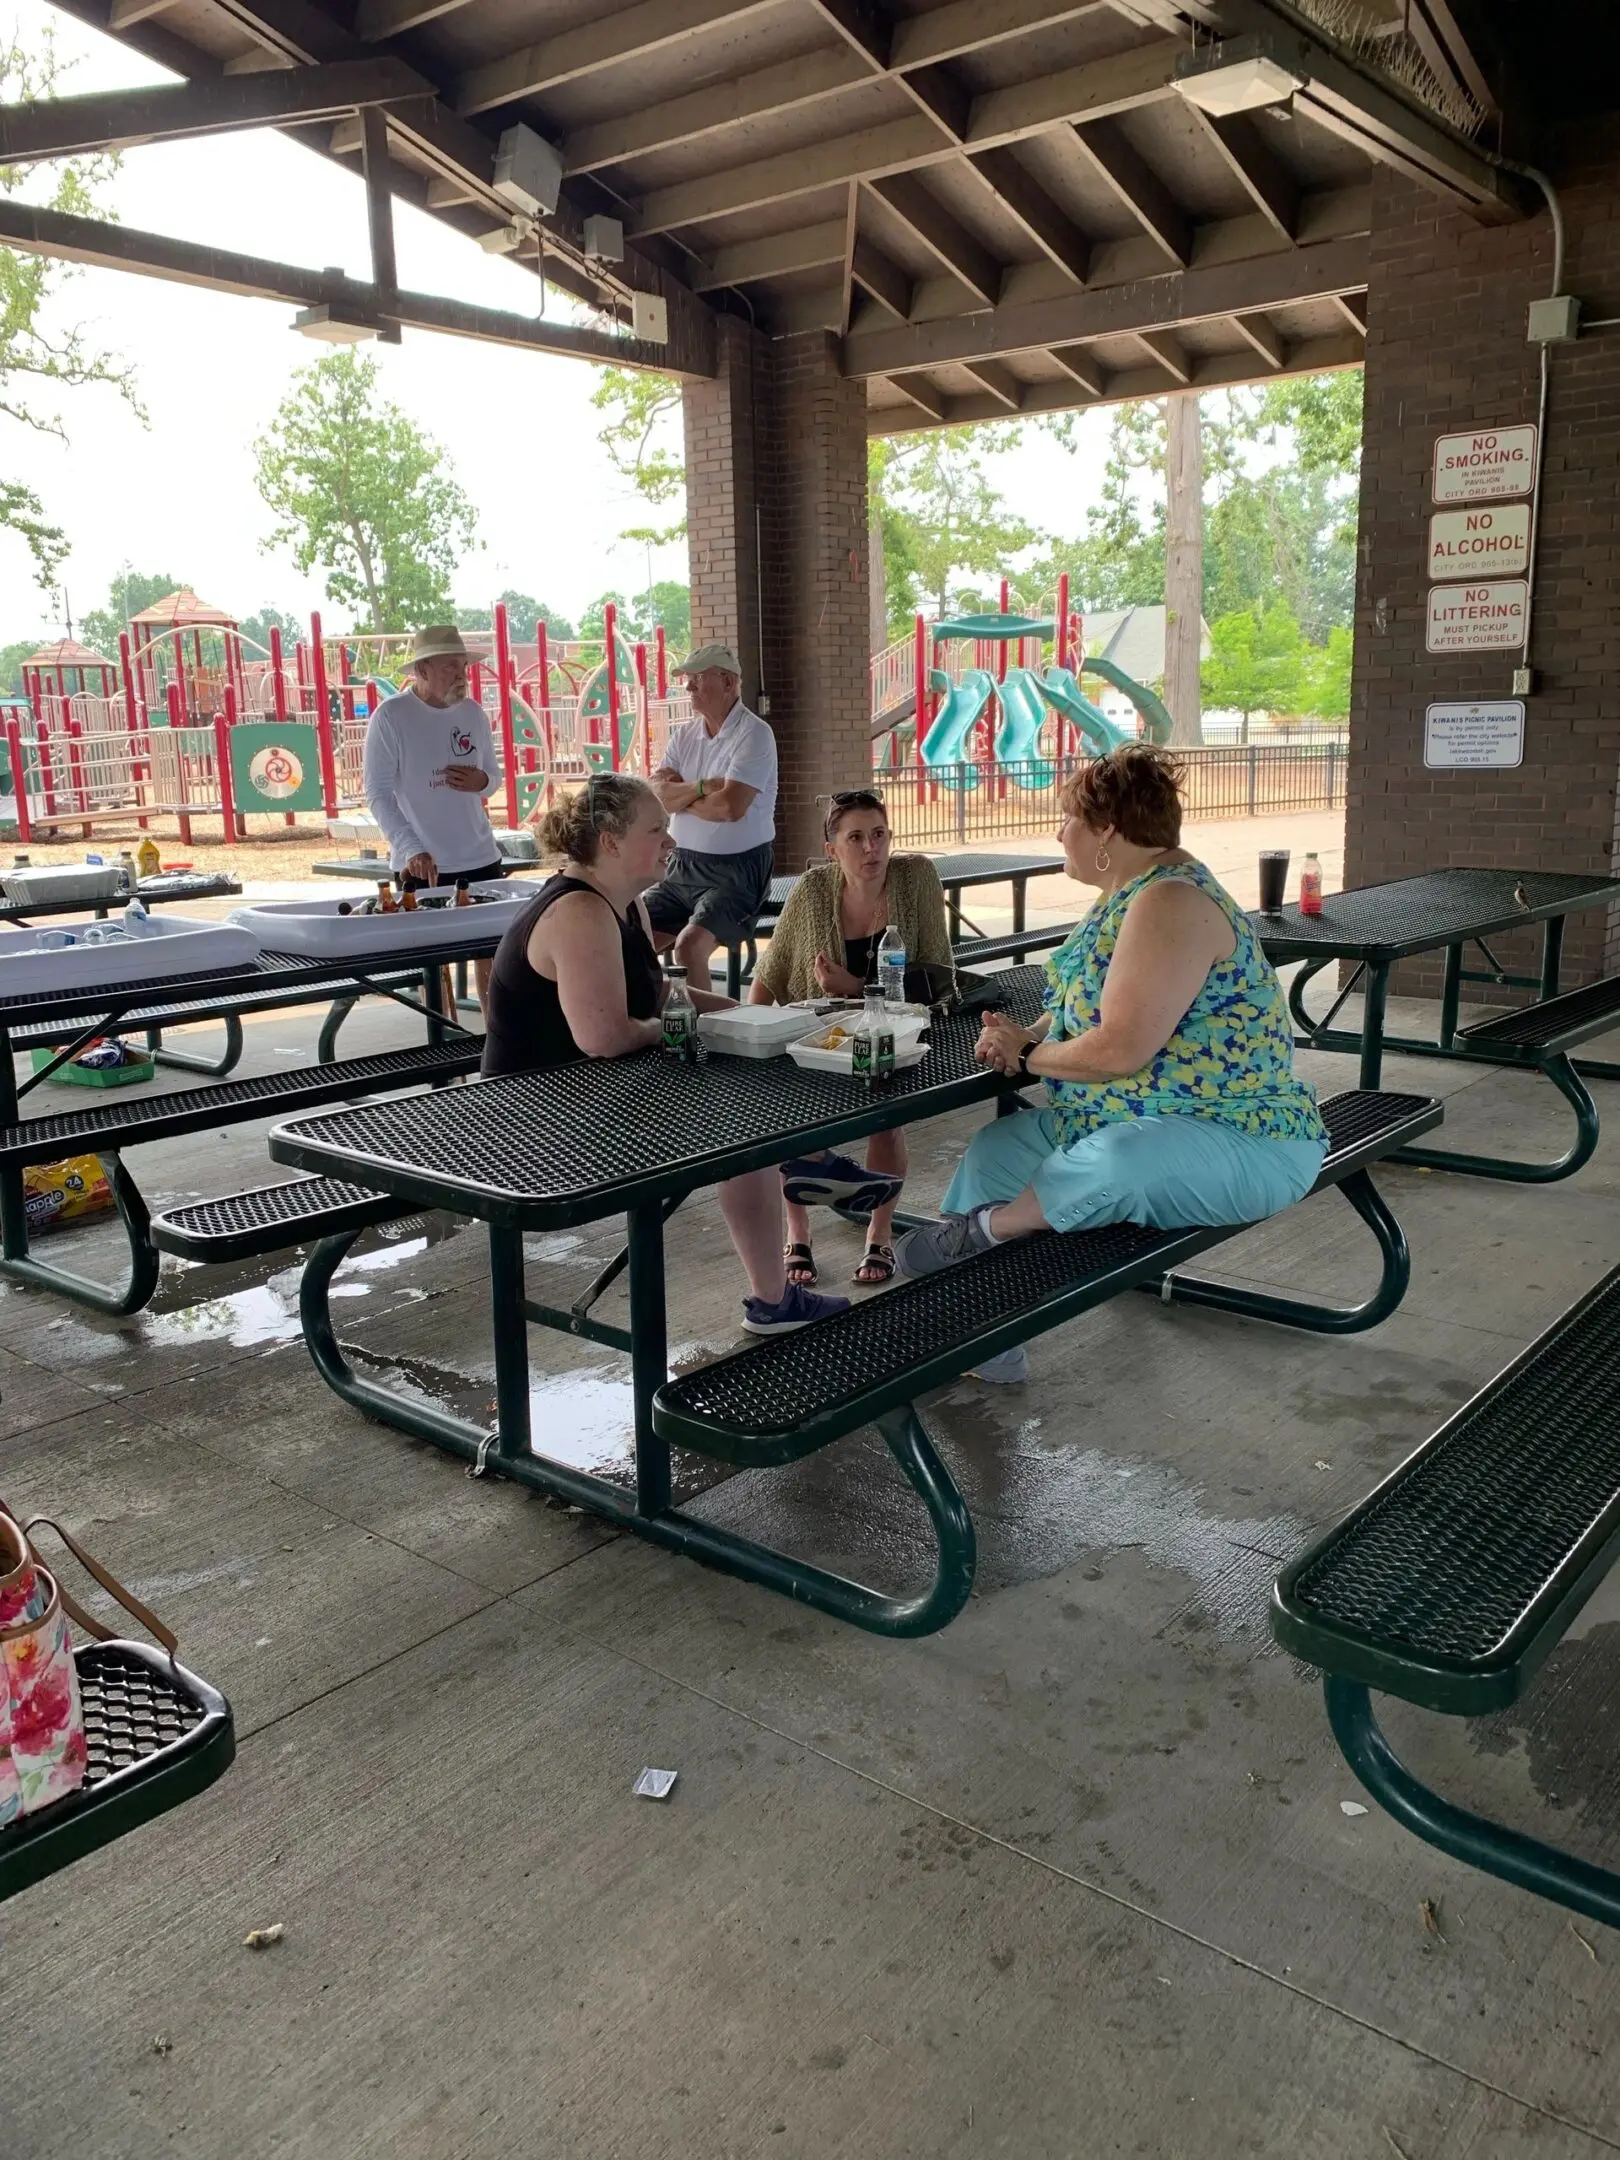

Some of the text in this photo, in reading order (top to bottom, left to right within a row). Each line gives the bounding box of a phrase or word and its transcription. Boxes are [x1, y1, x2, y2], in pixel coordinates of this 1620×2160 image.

[1472, 436, 1497, 451] NO
[1445, 448, 1524, 469] SMOKING
[1472, 467, 1504, 477] KIWANIS
[1464, 476, 1500, 486] PAVILION
[1445, 489, 1464, 498] CITY
[1466, 514, 1493, 531] NO
[1434, 535, 1524, 557] ALCOHOL
[1434, 563, 1454, 572] CITY
[1465, 589, 1489, 602] NO
[1433, 603, 1521, 621] LITTERING
[1444, 622, 1509, 634] MUST PICKUP
[1434, 633, 1518, 645] AFTER YOURSELF
[66, 1176, 82, 1188] 24
